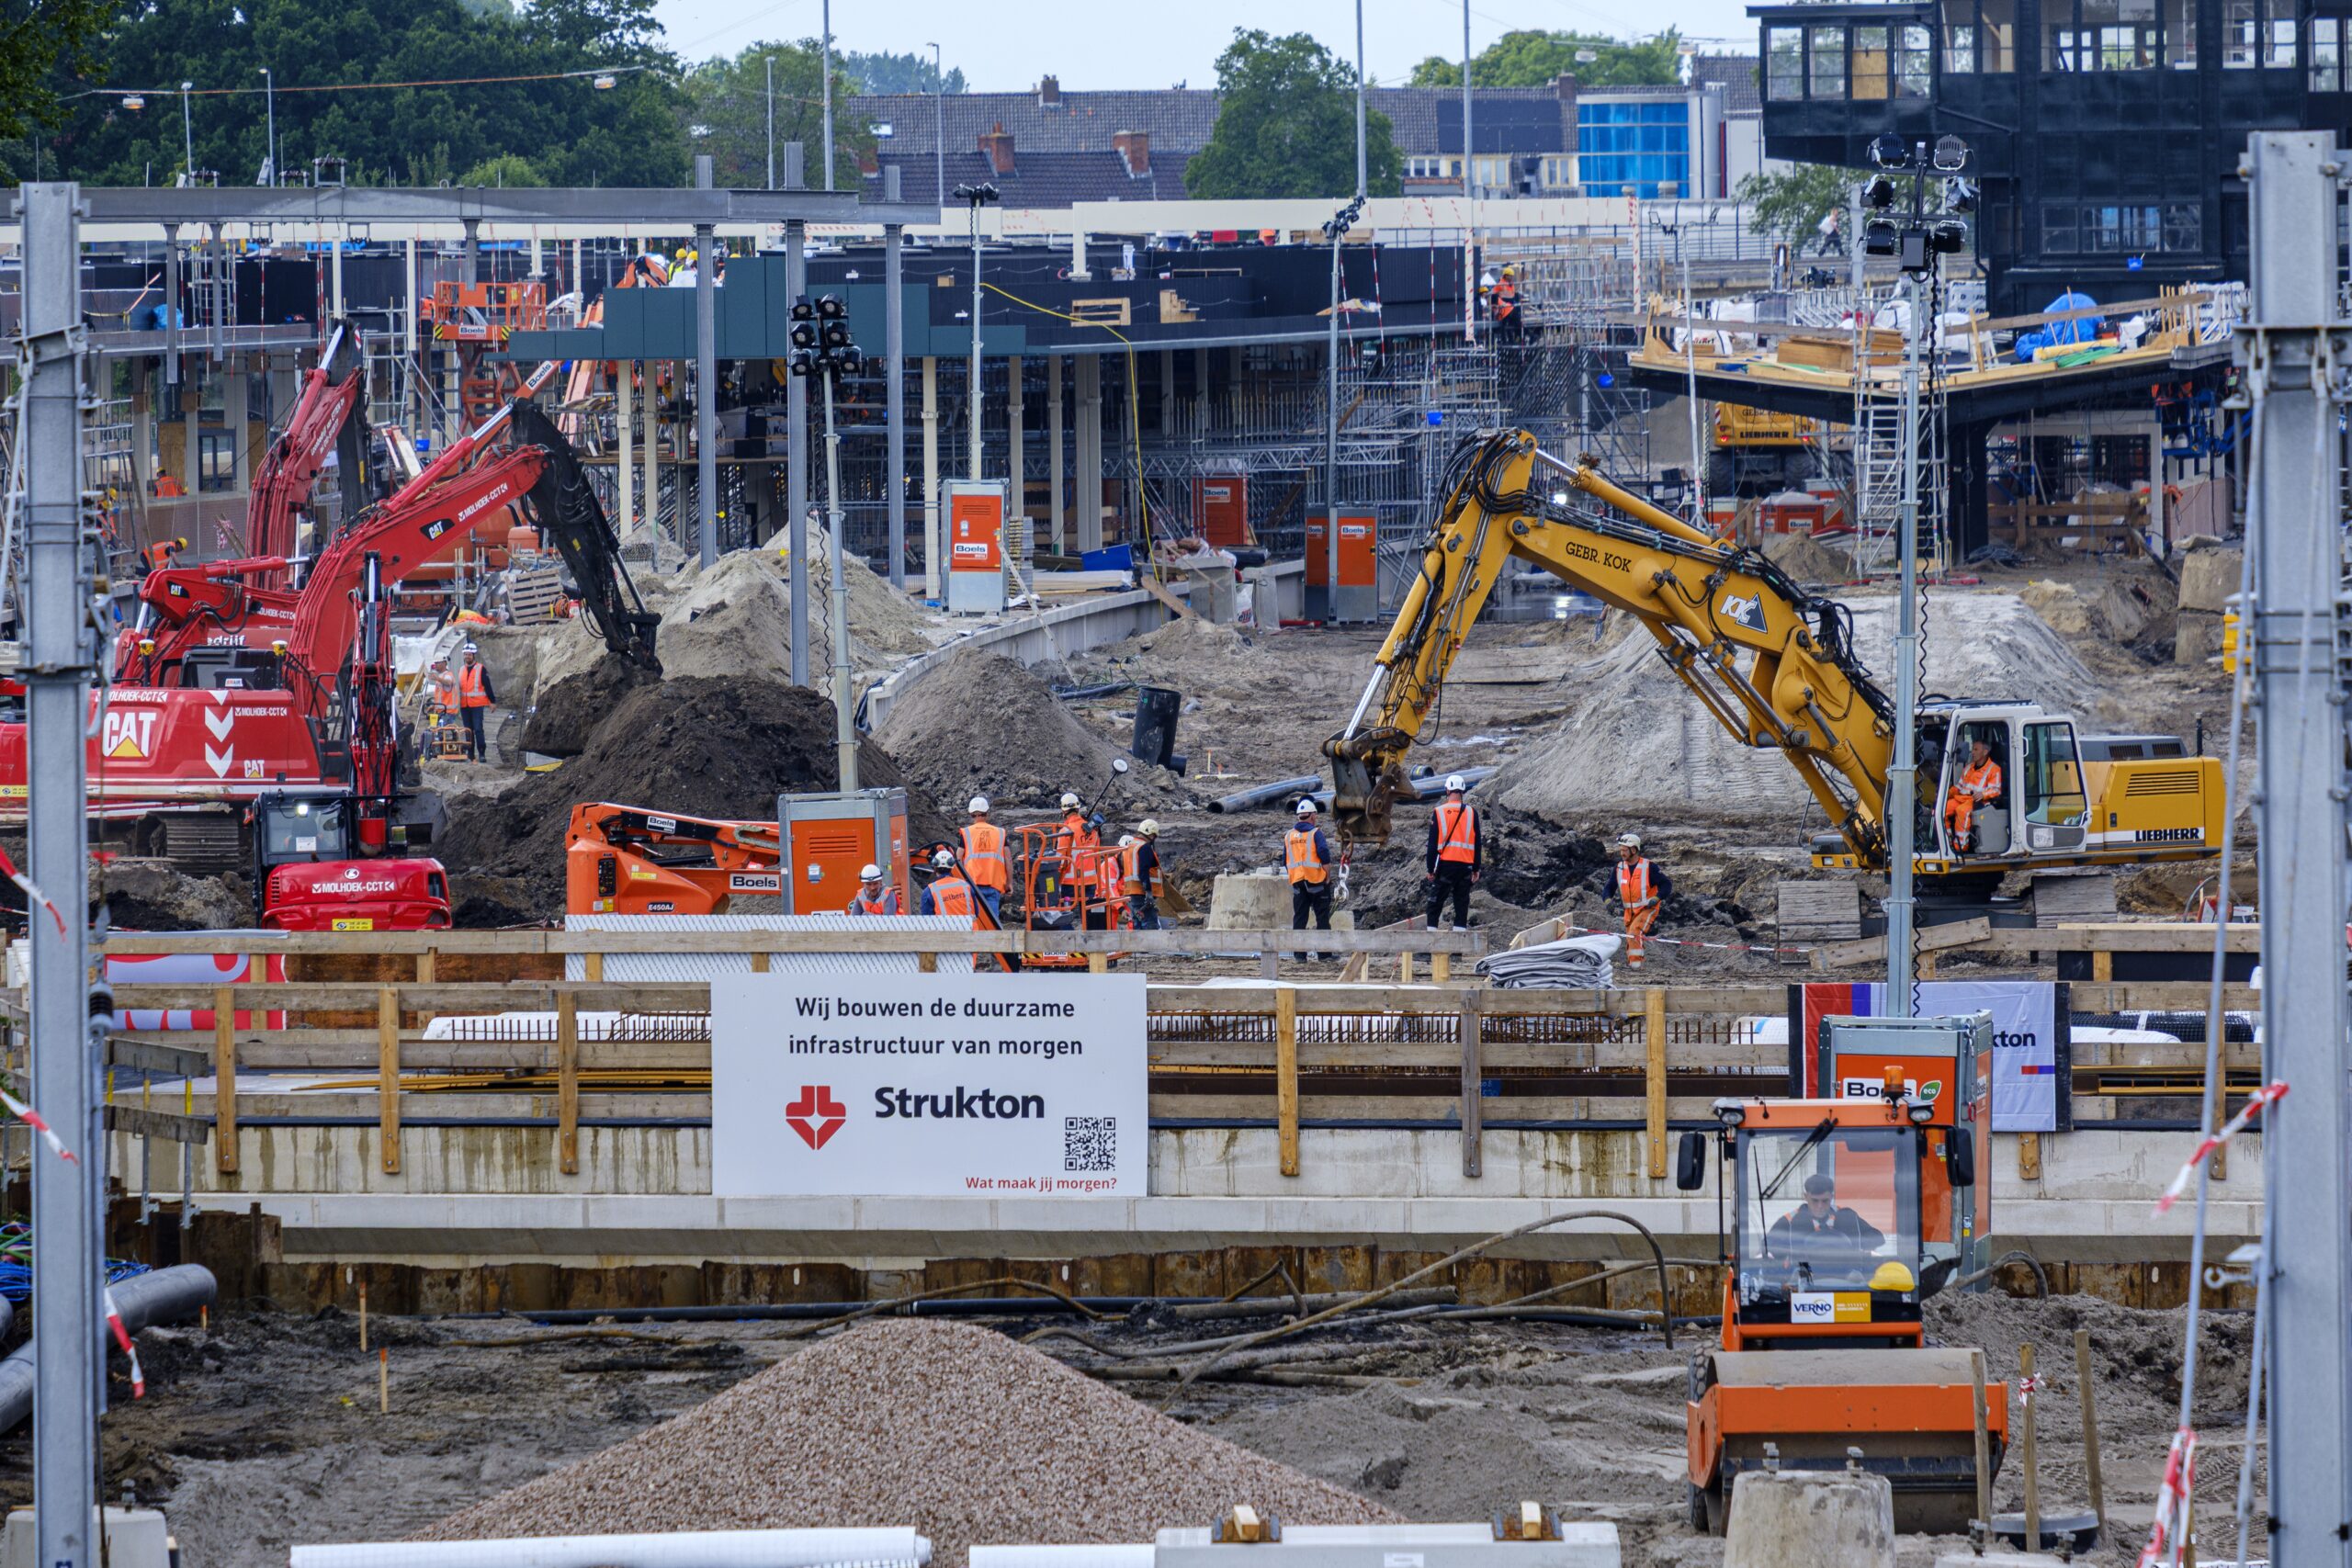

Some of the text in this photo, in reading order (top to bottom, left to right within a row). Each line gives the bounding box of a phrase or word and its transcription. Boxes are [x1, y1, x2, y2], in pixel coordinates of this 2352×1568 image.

[528, 363, 551, 388] Boels
[428, 520, 444, 539] CAT
[1566, 541, 1633, 572] GEBR. KOK
[170, 585, 182, 596] CAT
[258, 607, 290, 619] OLHOEK-CCT
[107, 691, 157, 703] OLHOEK-CCT
[241, 707, 281, 716] MOLHOEK-CCT
[102, 712, 156, 758] CAT
[243, 760, 265, 778] CAT
[649, 817, 675, 828] Boels
[2134, 828, 2199, 842] LIEBHERR
[322, 882, 384, 894] MOLHOEK-CCT
[732, 875, 777, 887] Boels
[647, 903, 675, 911] E450AJ
[796, 997, 1075, 1021] Wij bouwen de duurzame
[788, 1034, 1083, 1059] infrastructuur van morgen
[1847, 1082, 1913, 1097] Bos
[1923, 1087, 1938, 1095] eco
[875, 1086, 1045, 1119] Strukton
[966, 1177, 1117, 1192] Wat maak jij morgen?
[1793, 1303, 1832, 1314] VERNO
